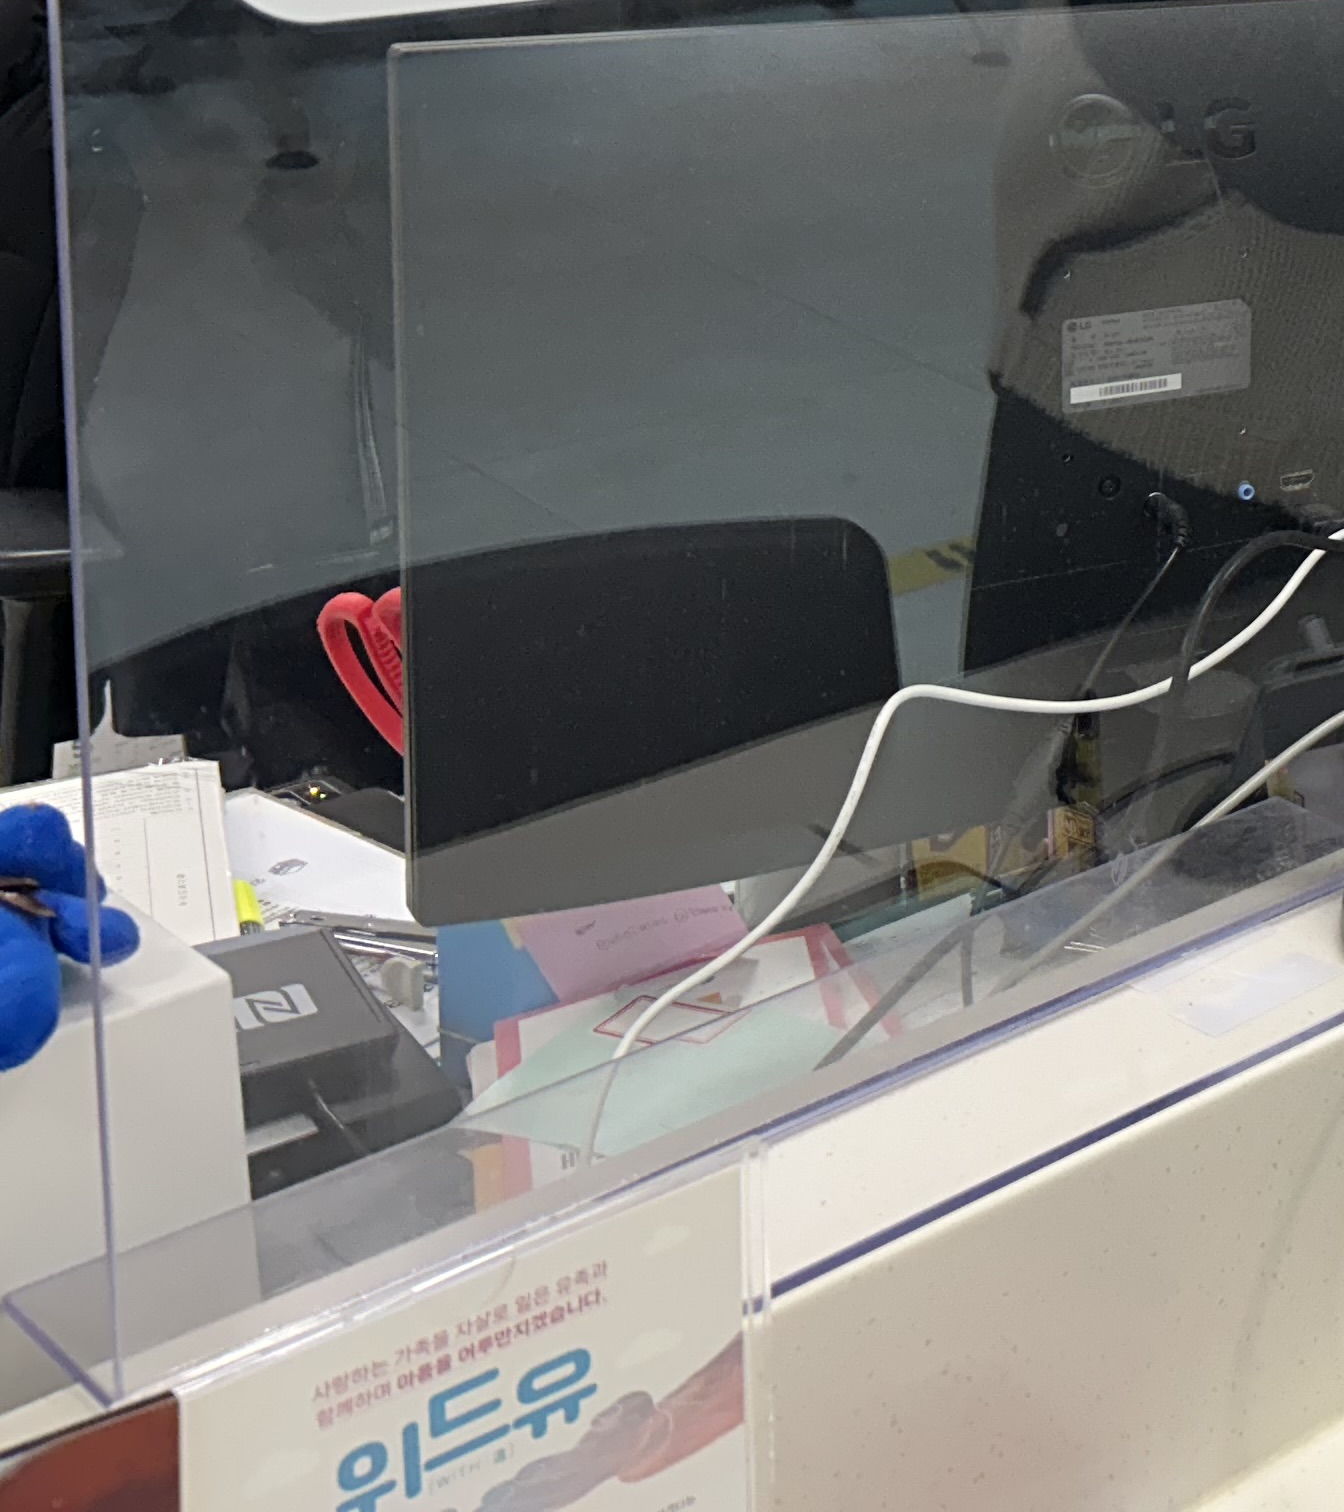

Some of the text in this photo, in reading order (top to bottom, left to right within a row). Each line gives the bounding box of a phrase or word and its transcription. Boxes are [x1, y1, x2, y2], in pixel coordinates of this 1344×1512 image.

[312, 1359, 390, 1402] 사랑하는
[394, 1329, 450, 1366] 가족을
[455, 1303, 509, 1338] 자살로
[316, 1381, 392, 1429] 함께하며
[397, 1353, 452, 1390] 아픔을
[336, 1347, 598, 1512] 위드유
